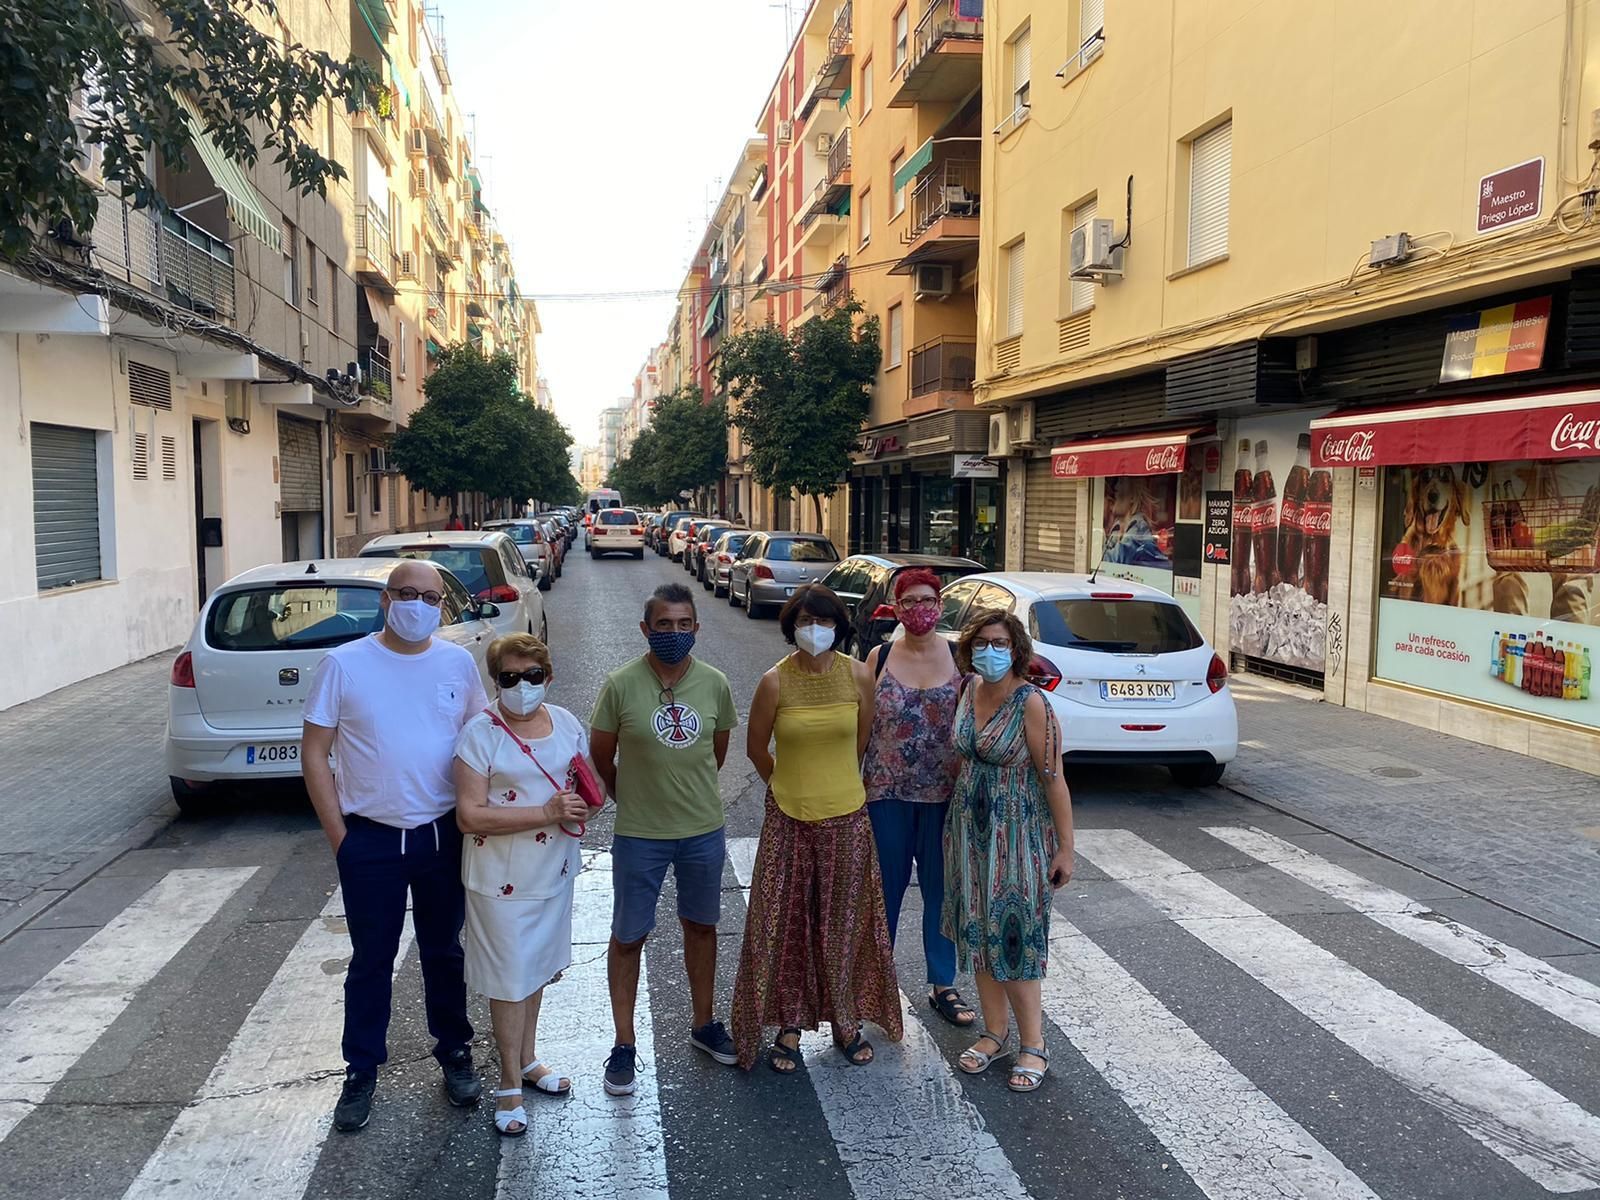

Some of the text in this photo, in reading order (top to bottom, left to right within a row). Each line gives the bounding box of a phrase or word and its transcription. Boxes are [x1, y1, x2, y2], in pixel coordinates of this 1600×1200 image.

[1491, 190, 1526, 207] Maestro
[1481, 201, 1535, 225] Priego López
[1551, 412, 1600, 451] Coca-
[1320, 430, 1376, 462] Coca-Cola
[1146, 446, 1179, 471] Coca-Cola
[1211, 519, 1226, 527] ZERO
[1282, 503, 1305, 525] Coca-Col
[1395, 641, 1470, 663] para cada ocasión
[1408, 632, 1456, 650] Un refresco
[1110, 683, 1172, 697] 6483 KDK
[258, 745, 298, 761] 4083
